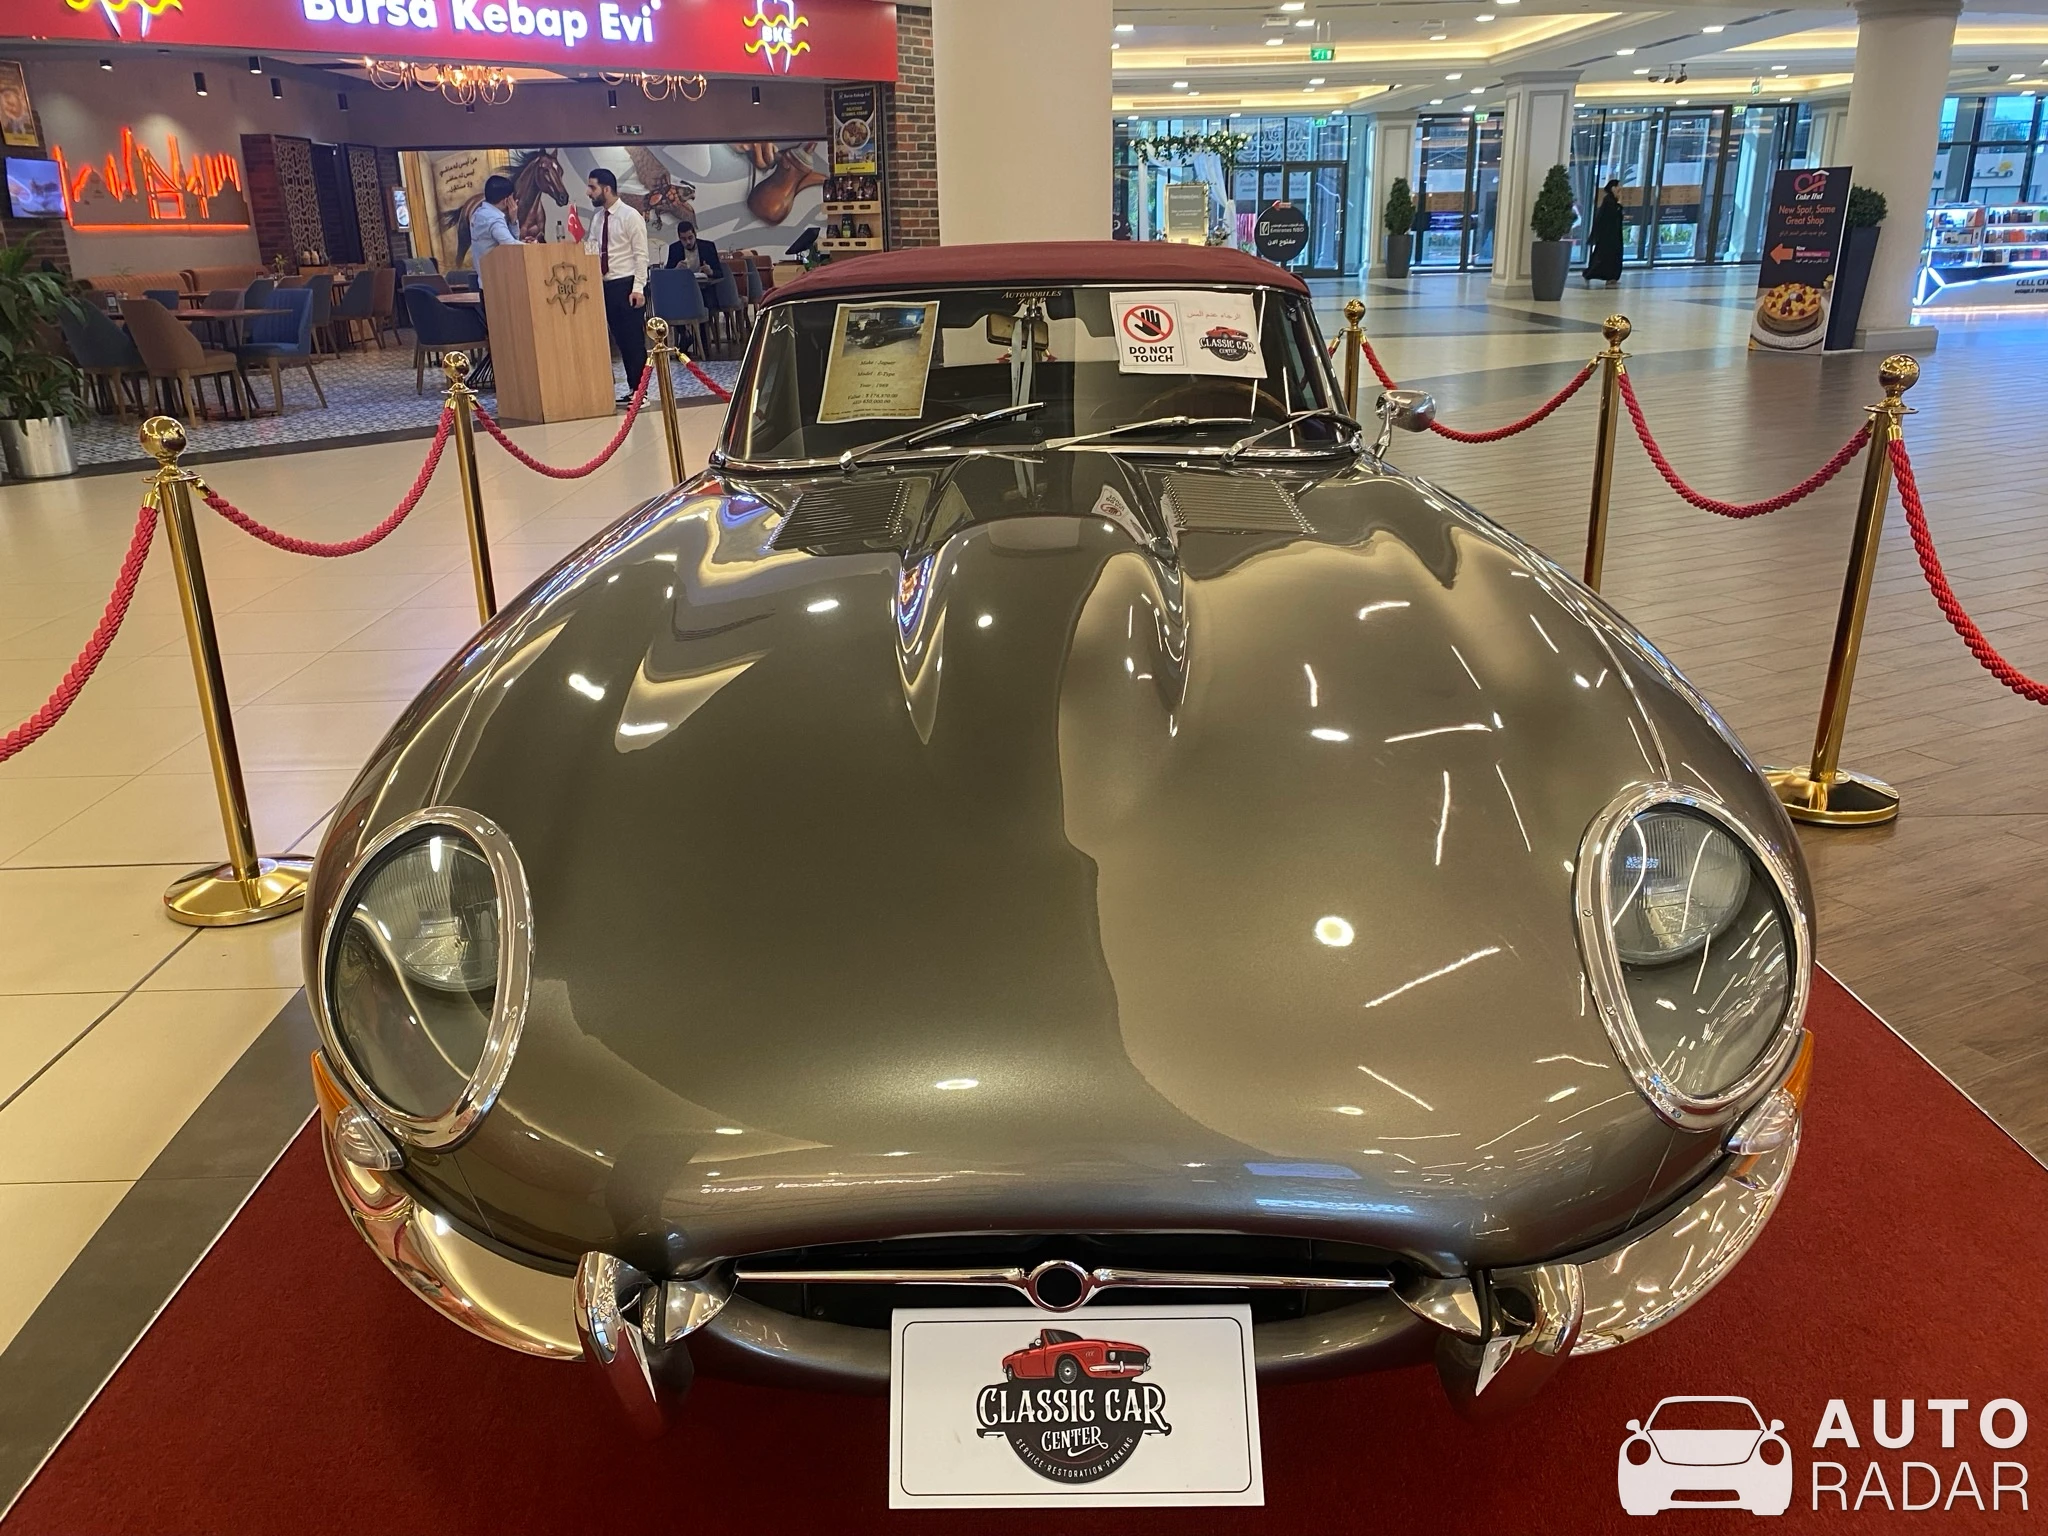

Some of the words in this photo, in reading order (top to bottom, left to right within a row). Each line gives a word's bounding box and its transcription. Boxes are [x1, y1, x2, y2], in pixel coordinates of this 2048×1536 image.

[304, 0, 438, 28] Bursa
[453, 0, 588, 46] Kebap
[600, 2, 655, 42] Evi
[761, 25, 793, 43] BKE
[1779, 205, 1795, 214] New
[1796, 204, 1814, 216] Spot,
[1816, 204, 1836, 214] Same
[1785, 216, 1806, 225] Great
[1807, 216, 1825, 227] Shop
[1129, 346, 1147, 354] DO
[1150, 345, 1175, 354] NOT
[1200, 338, 1235, 349] CLASSIC
[1236, 340, 1254, 352] CAR
[1133, 355, 1174, 363] TOUCH
[978, 1387, 1096, 1427] CLASSIC
[1104, 1386, 1169, 1431] CAR
[1041, 1426, 1109, 1457] CENTER
[1015, 1438, 1045, 1468] SERVICE
[1046, 1464, 1104, 1479] RESTORATION
[1104, 1436, 1134, 1468] PARKING
